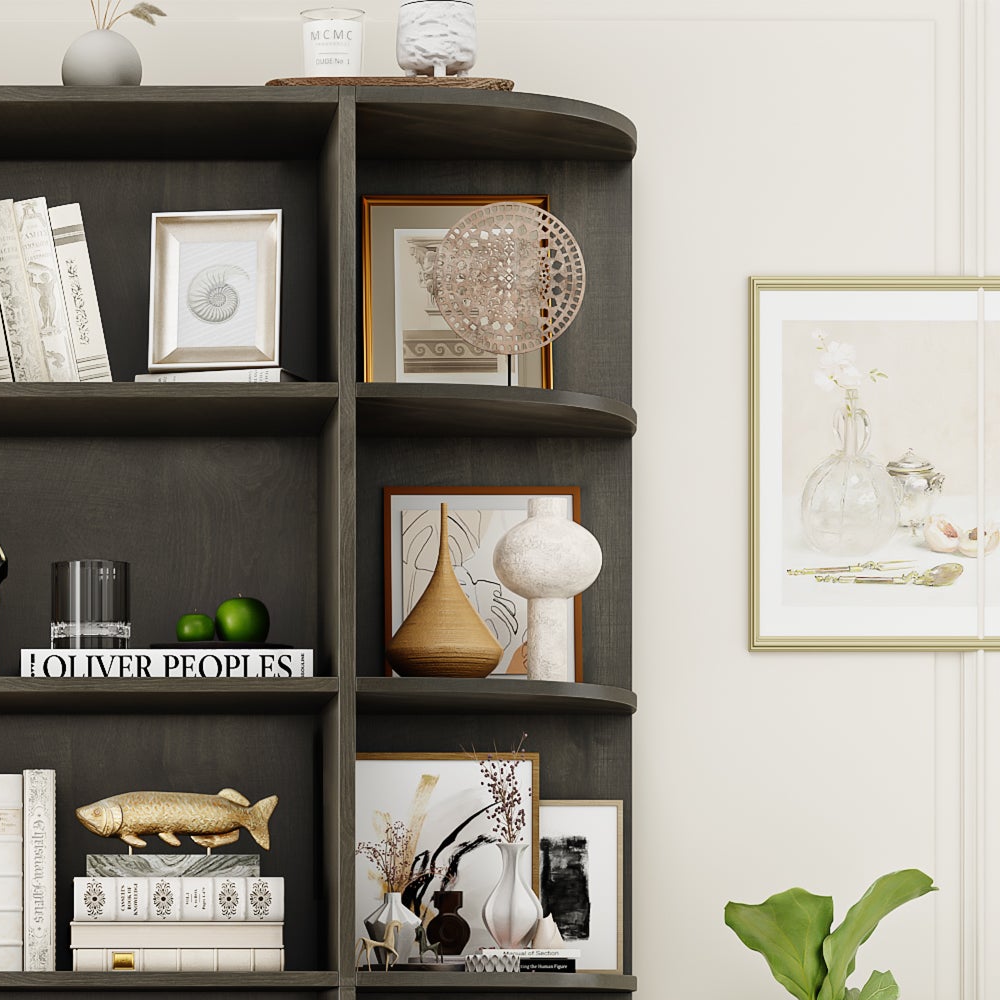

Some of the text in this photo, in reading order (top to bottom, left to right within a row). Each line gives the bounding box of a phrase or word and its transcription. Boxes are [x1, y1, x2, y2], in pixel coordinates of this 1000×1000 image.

[311, 30, 352, 40] MCMC
[43, 654, 293, 677] OLIVER PEOPLES
